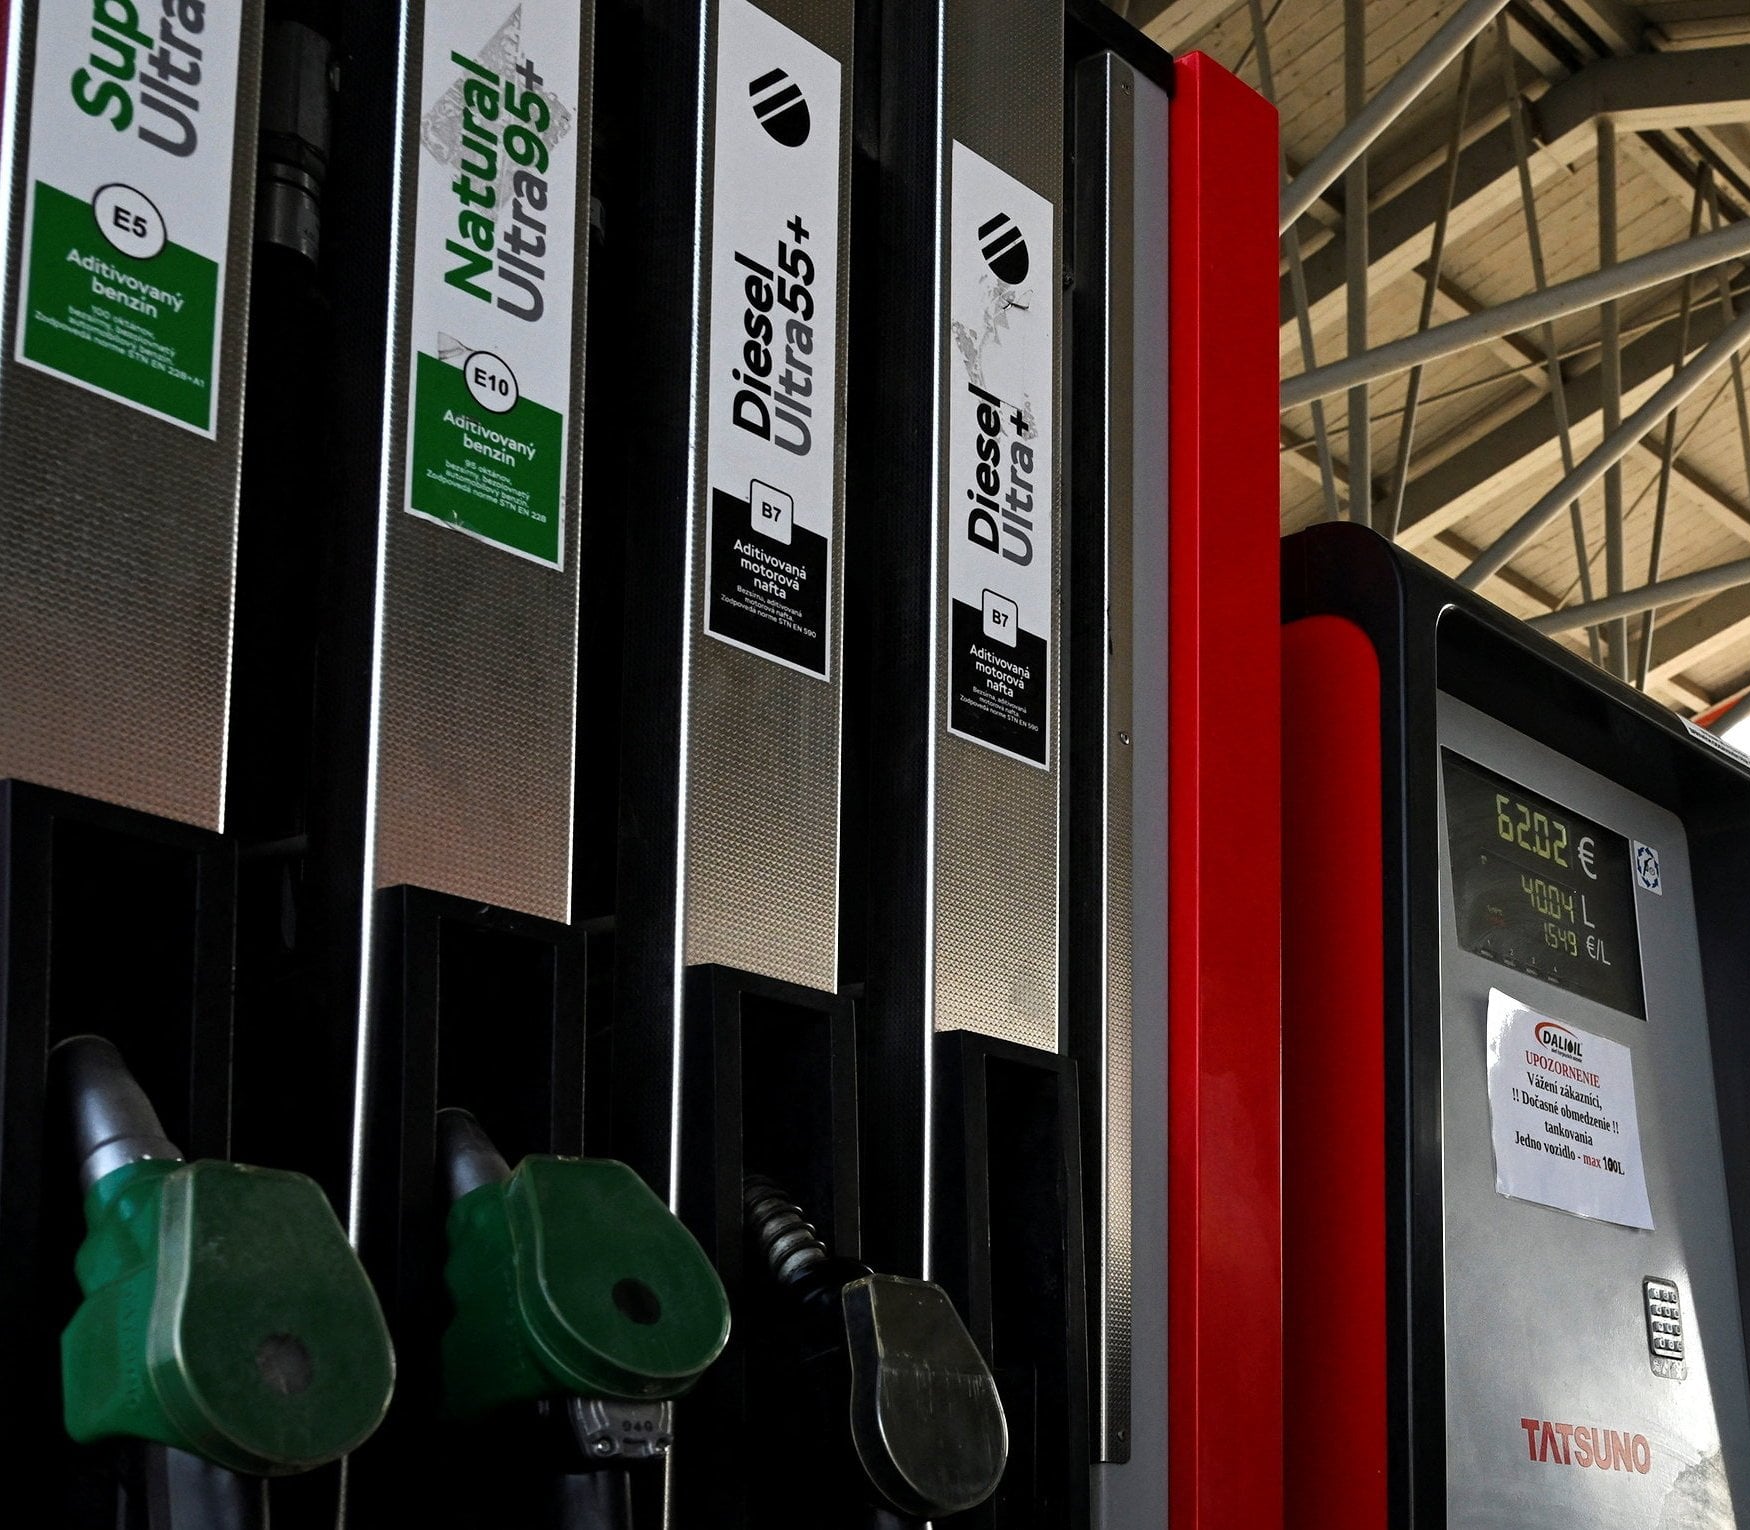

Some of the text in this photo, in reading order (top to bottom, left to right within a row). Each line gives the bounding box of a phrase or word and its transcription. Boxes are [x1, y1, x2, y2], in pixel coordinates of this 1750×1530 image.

[138, 0, 206, 158] Ultra
[444, 50, 500, 303] Natural
[497, 59, 551, 322] Ultra95+
[112, 205, 148, 239] E5
[66, 248, 184, 314] Aditivovaný
[91, 274, 158, 319] benzín
[732, 251, 774, 442] Diesel
[774, 214, 815, 457] Ultra55+
[474, 367, 509, 397] E10
[443, 409, 535, 462] Aditivovaný
[463, 431, 515, 467] benzín
[967, 382, 1001, 554] Diesel
[1002, 410, 1035, 567] Ultra+
[761, 501, 782, 522] B7
[733, 540, 806, 580] Aditivovaná
[740, 558, 799, 591] motorová
[753, 578, 786, 599] nafta
[778, 617, 791, 628] STN
[793, 623, 801, 632] EN
[992, 609, 1009, 628] B7
[969, 645, 1029, 679] Aditivovaná
[975, 661, 1024, 689] motorová
[986, 679, 1013, 698] nafta
[1577, 837, 1598, 880] €
[1581, 894, 1596, 929] L
[1586, 935, 1612, 966] €/L
[1525, 1050, 1600, 1089] UPOZORNENIE
[1512, 1087, 1619, 1134] !! Dočasné obmedzenie !!
[1527, 1072, 1602, 1111] Vážení zákazníci,
[1514, 1129, 1541, 1151] Jedno
[1543, 1141, 1575, 1160] vozidlo
[1582, 1153, 1601, 1168] max
[1544, 1120, 1592, 1146] tankovania
[1520, 1418, 1651, 1474] TATSUNO
